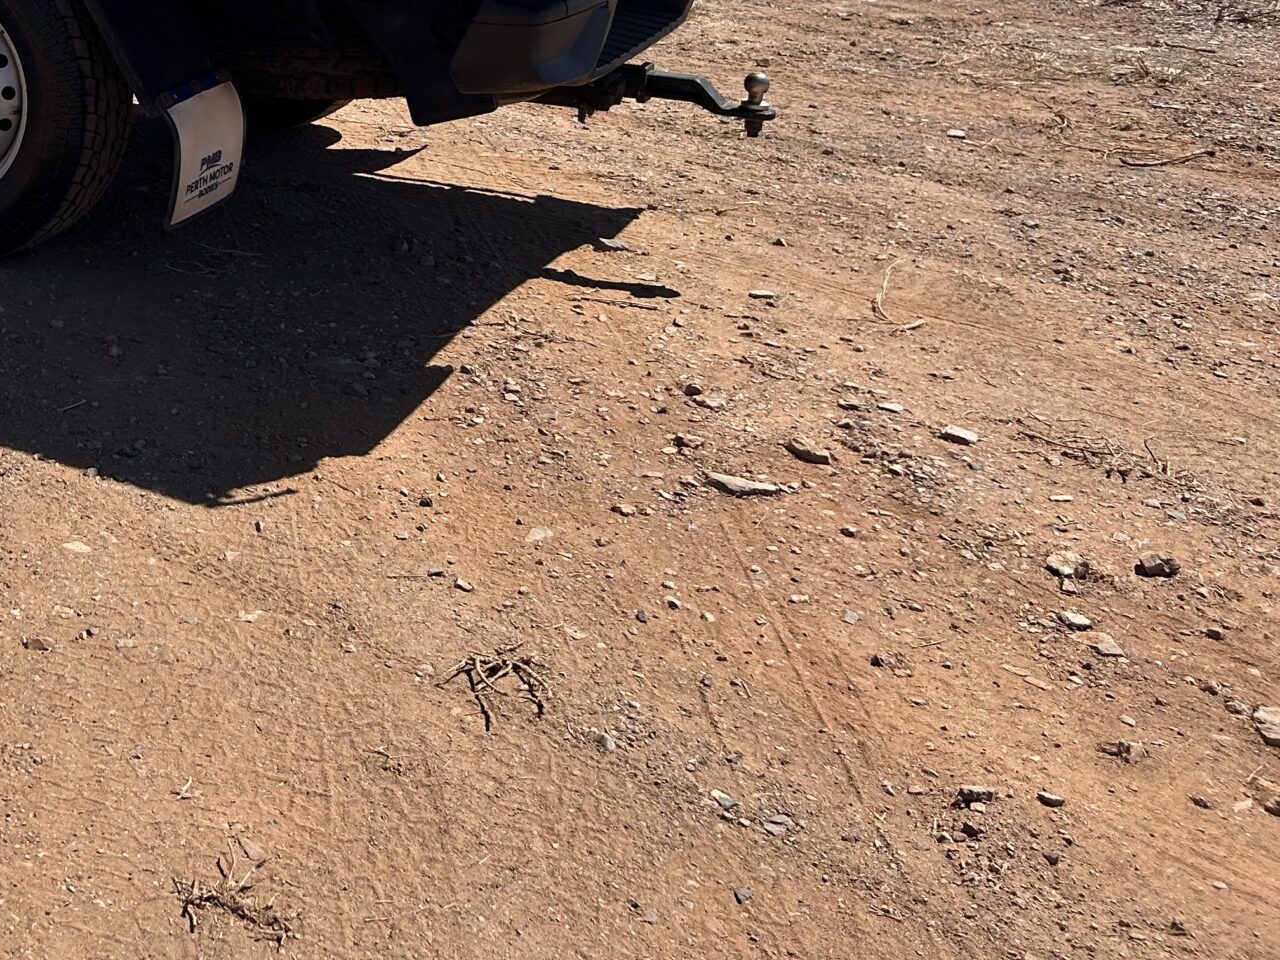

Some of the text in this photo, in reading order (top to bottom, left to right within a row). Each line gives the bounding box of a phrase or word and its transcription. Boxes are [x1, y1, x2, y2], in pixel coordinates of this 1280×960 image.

[200, 150, 222, 171] PMB
[186, 162, 234, 196] PERTH MOTOR
